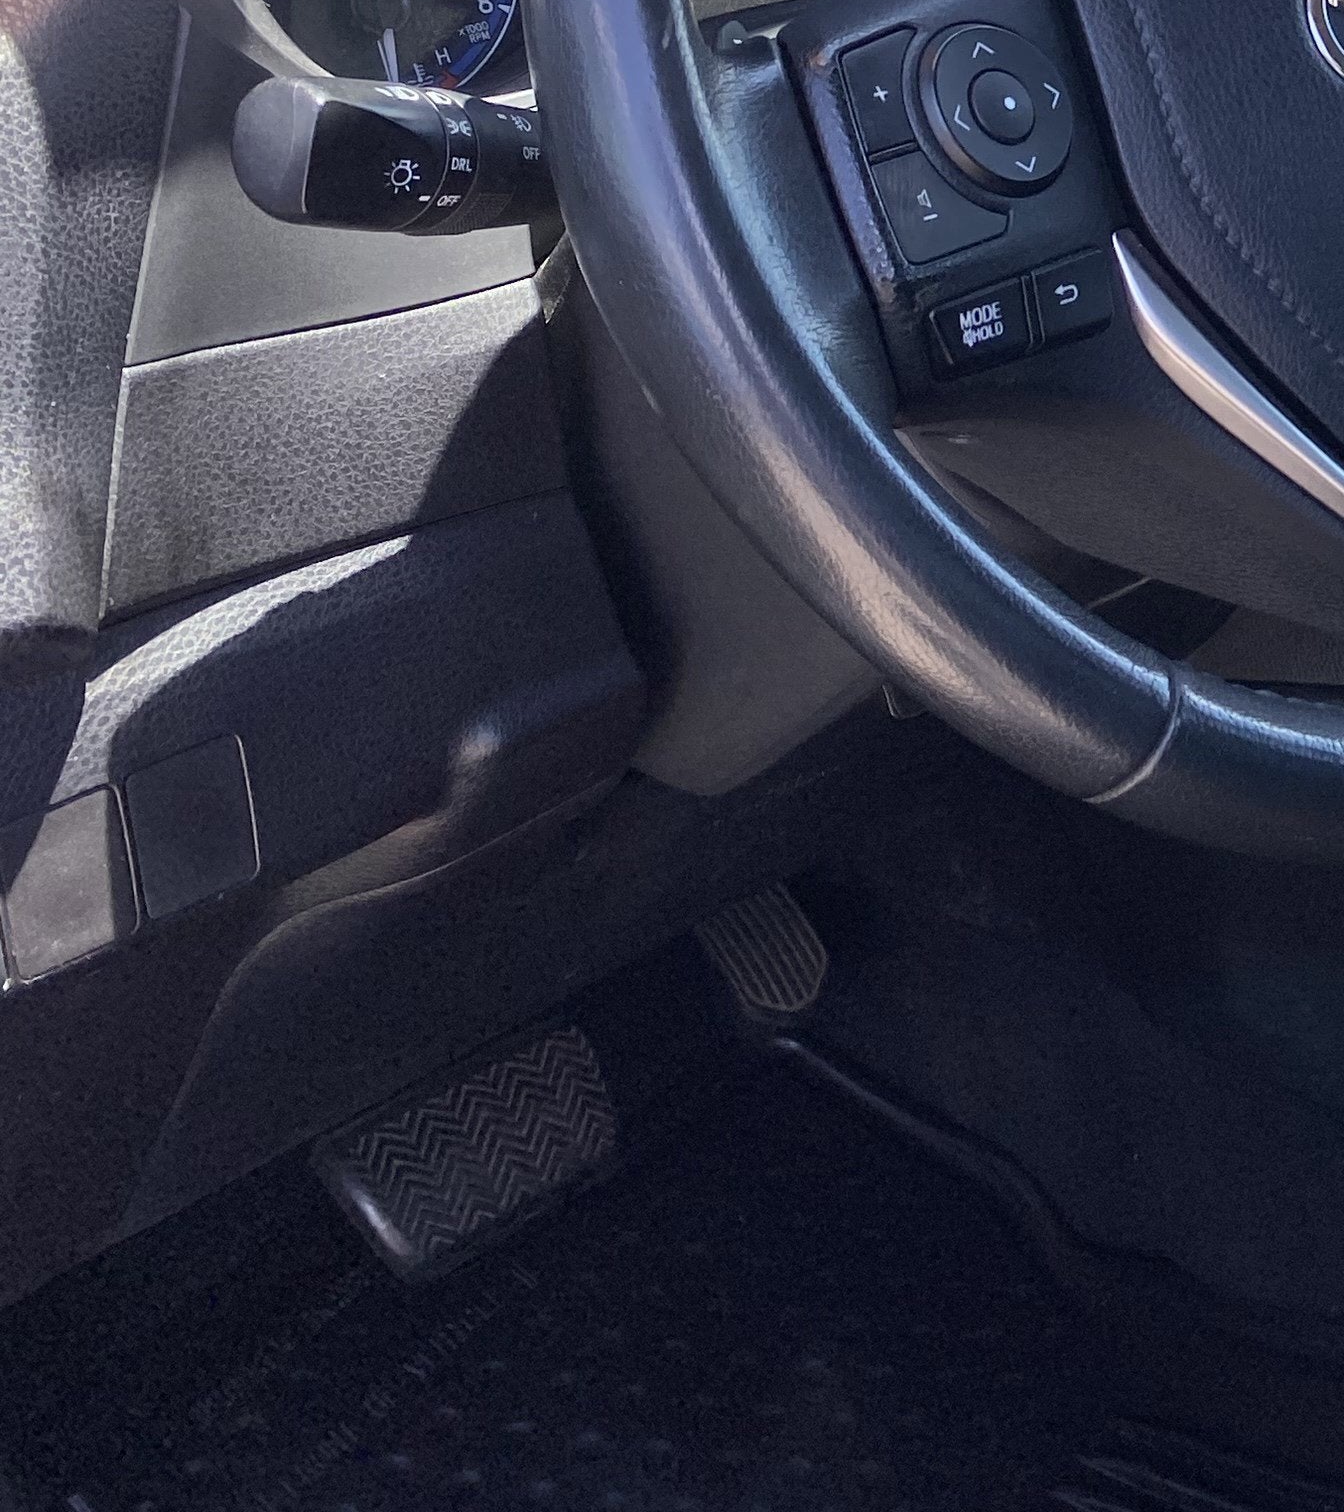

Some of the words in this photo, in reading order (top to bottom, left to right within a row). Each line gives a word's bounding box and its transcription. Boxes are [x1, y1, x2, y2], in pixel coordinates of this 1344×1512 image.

[469, 31, 491, 43] RPM
[434, 47, 451, 65] H
[522, 146, 540, 160] OFF
[451, 157, 472, 172] DRL
[437, 195, 461, 206] OFF
[960, 301, 1002, 330] MODE
[974, 321, 1004, 344] HOLD
